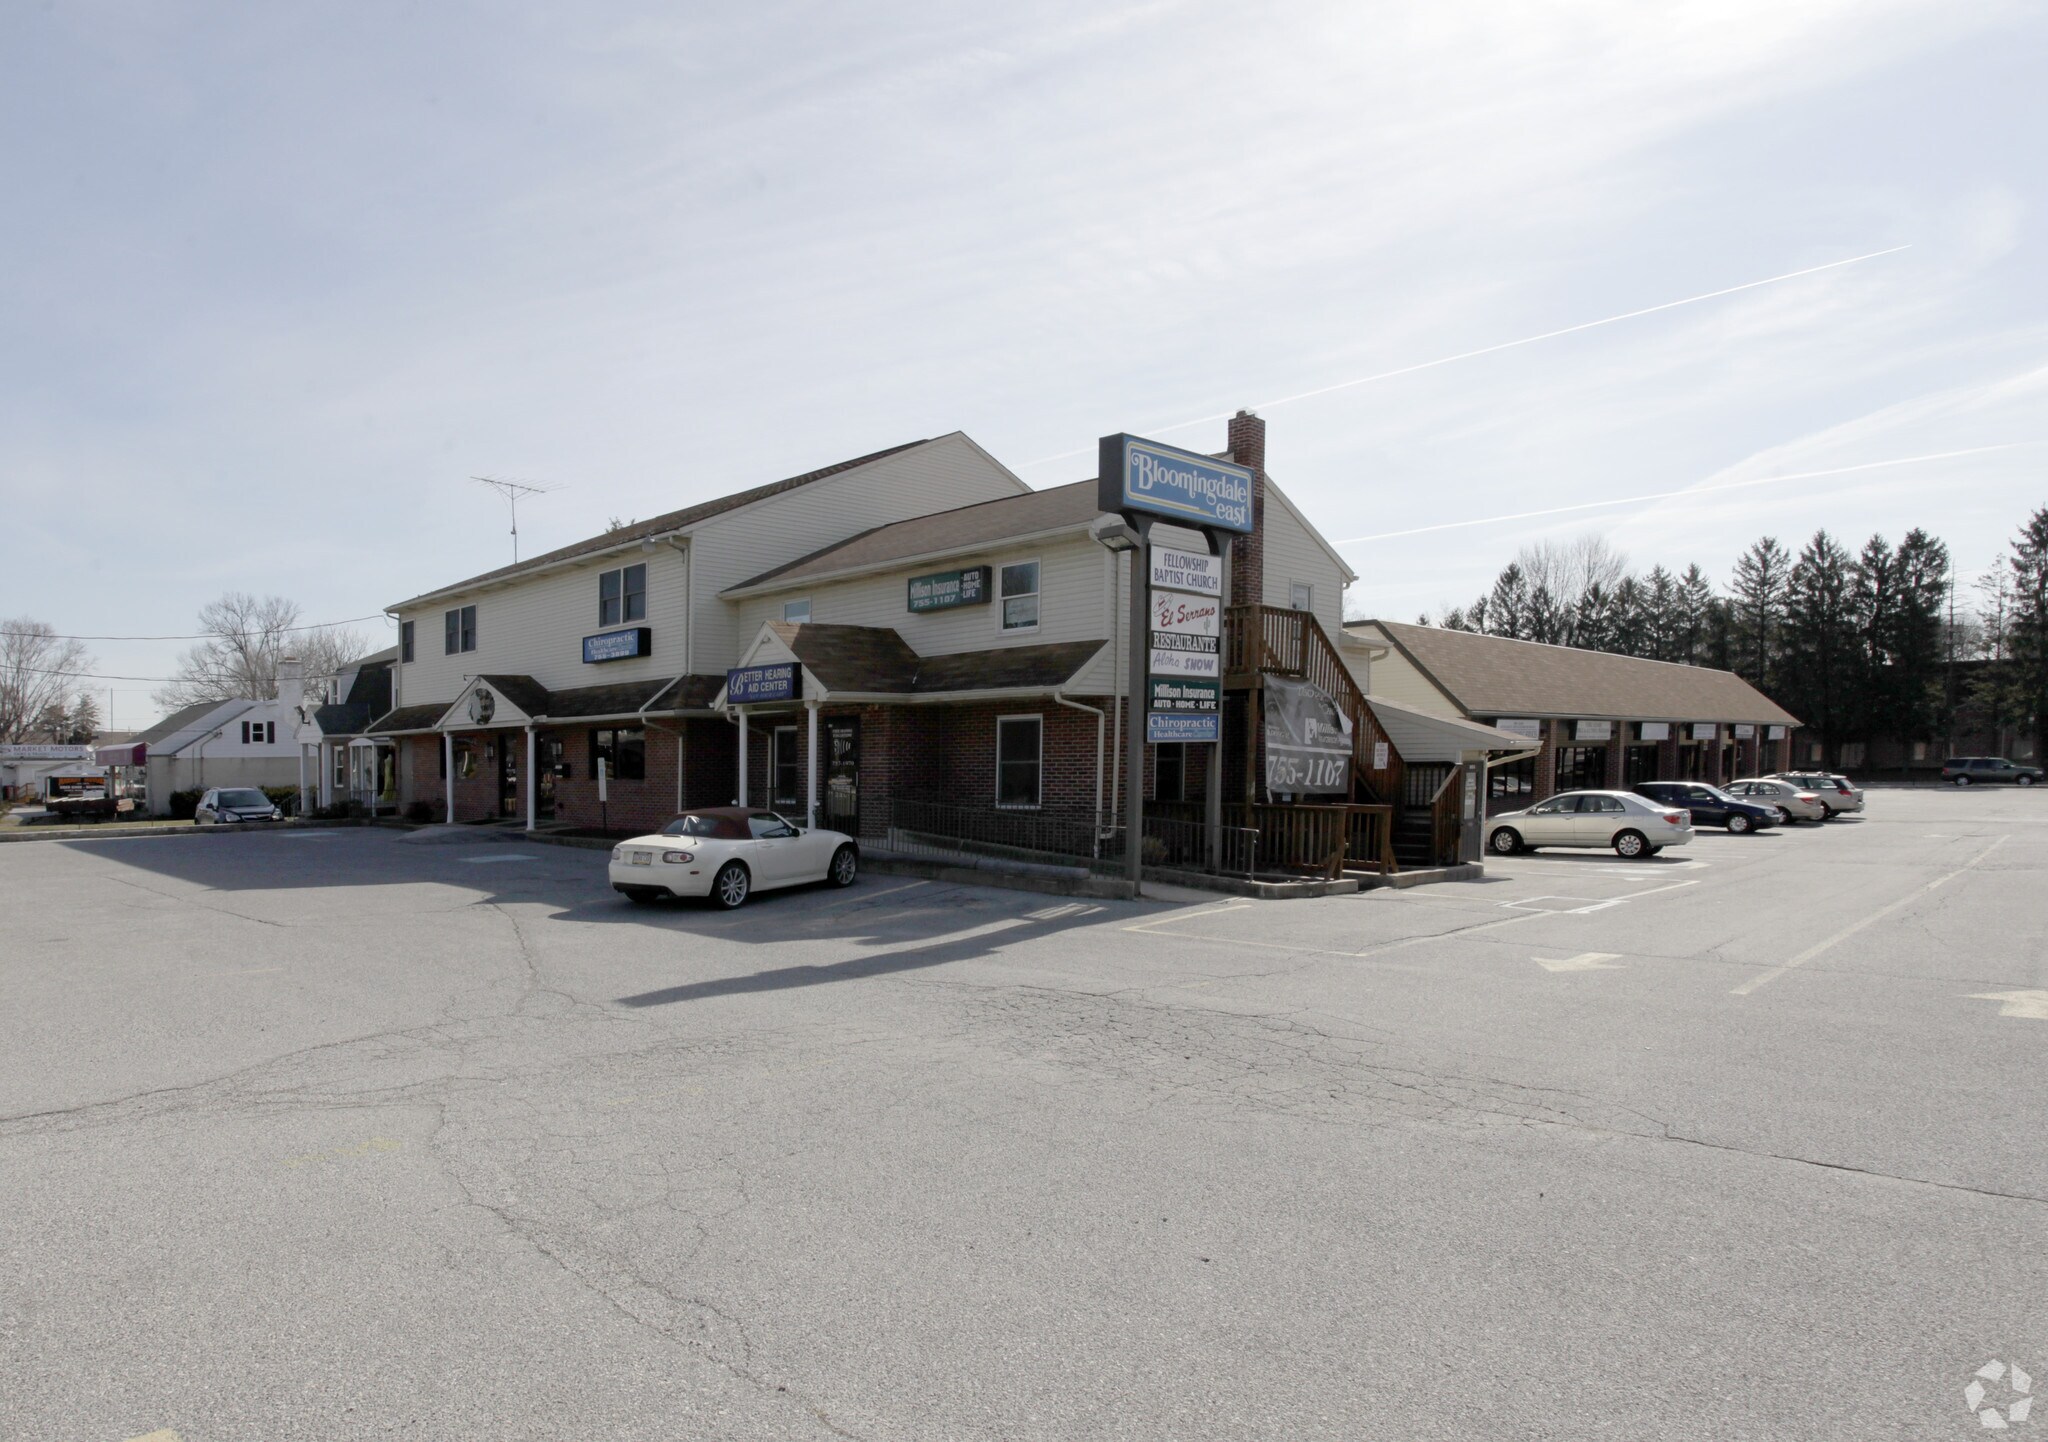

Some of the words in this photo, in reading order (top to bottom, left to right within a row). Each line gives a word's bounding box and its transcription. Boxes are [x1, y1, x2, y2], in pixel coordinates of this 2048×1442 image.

[1131, 453, 1247, 506] Bloomingdale
[1216, 503, 1246, 526] east
[1164, 553, 1209, 573] FELLOWSHIP
[963, 580, 980, 590] HOME
[1154, 568, 1184, 585] BAPTIST
[1187, 573, 1218, 590] CHURCH
[932, 579, 960, 595] Insurance
[963, 589, 976, 598] LIFE
[913, 594, 956, 607] 755-1107
[1161, 608, 1173, 627] El
[1177, 604, 1215, 623] Serrano
[588, 632, 634, 647] Chiropractic
[1153, 632, 1217, 652] RESTAURANTE
[1153, 652, 1180, 668] Aloha
[764, 667, 792, 680] HEARING
[748, 682, 759, 693] AID
[760, 680, 788, 692] CENTER
[1154, 684, 1181, 698] Millison
[1182, 685, 1215, 699] Insurance
[1153, 699, 1171, 708] AUTO
[1176, 700, 1195, 709] HOME
[1199, 701, 1216, 709] LIFE
[1150, 717, 1216, 731] Chiropractic
[1154, 730, 1192, 738] Healthcare
[1268, 755, 1345, 786] 755-1107
